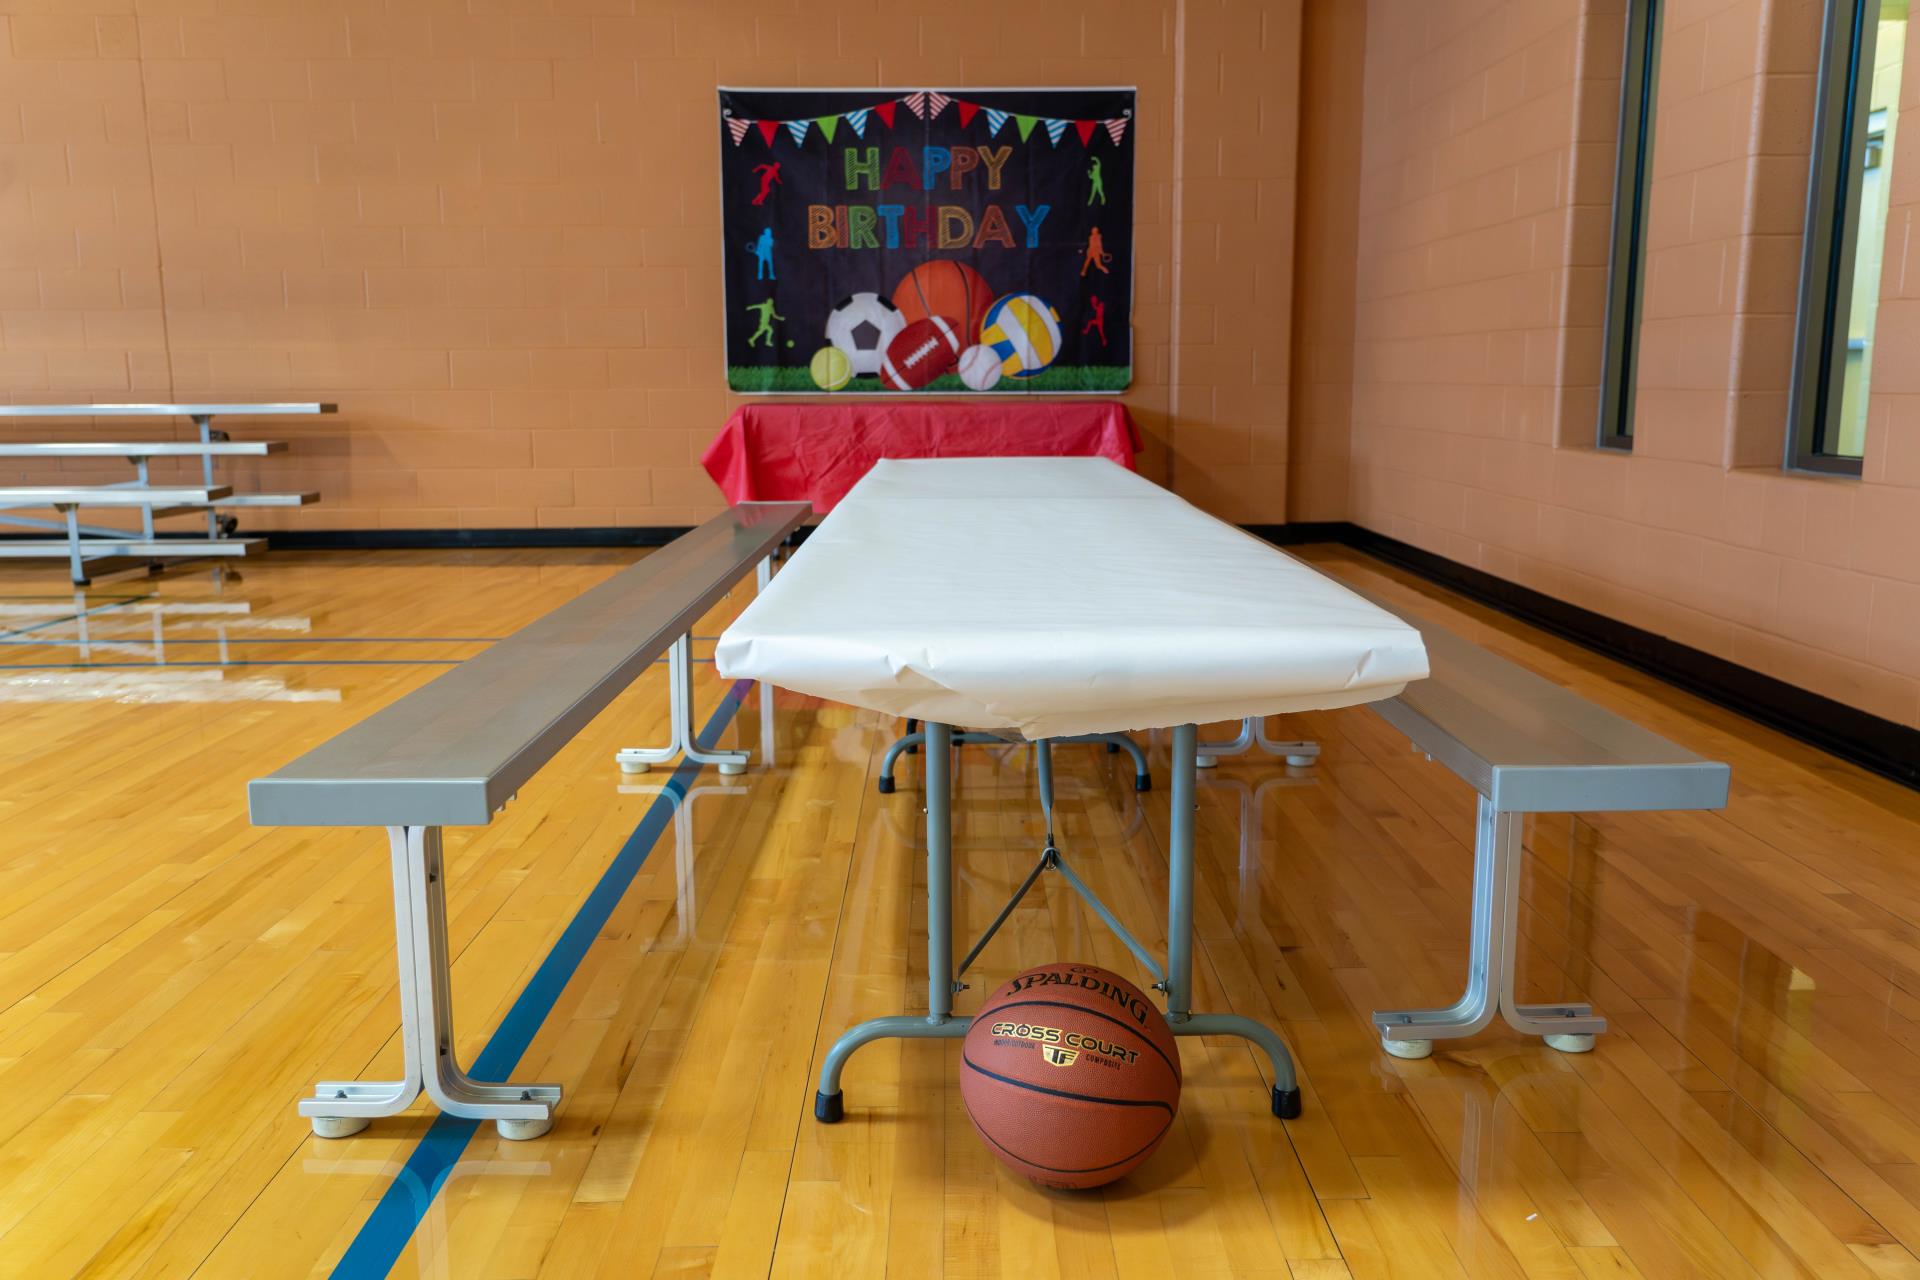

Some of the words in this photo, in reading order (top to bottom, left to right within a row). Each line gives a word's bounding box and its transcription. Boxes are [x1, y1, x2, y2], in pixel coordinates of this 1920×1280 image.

[844, 146, 1013, 190] HAPPY
[808, 204, 1050, 249] BIRTHDAY
[1007, 973, 1149, 1025] SPALDING
[991, 1022, 1063, 1044] CROSS
[1065, 1032, 1139, 1065] COURT
[1044, 1046, 1078, 1065] TF
